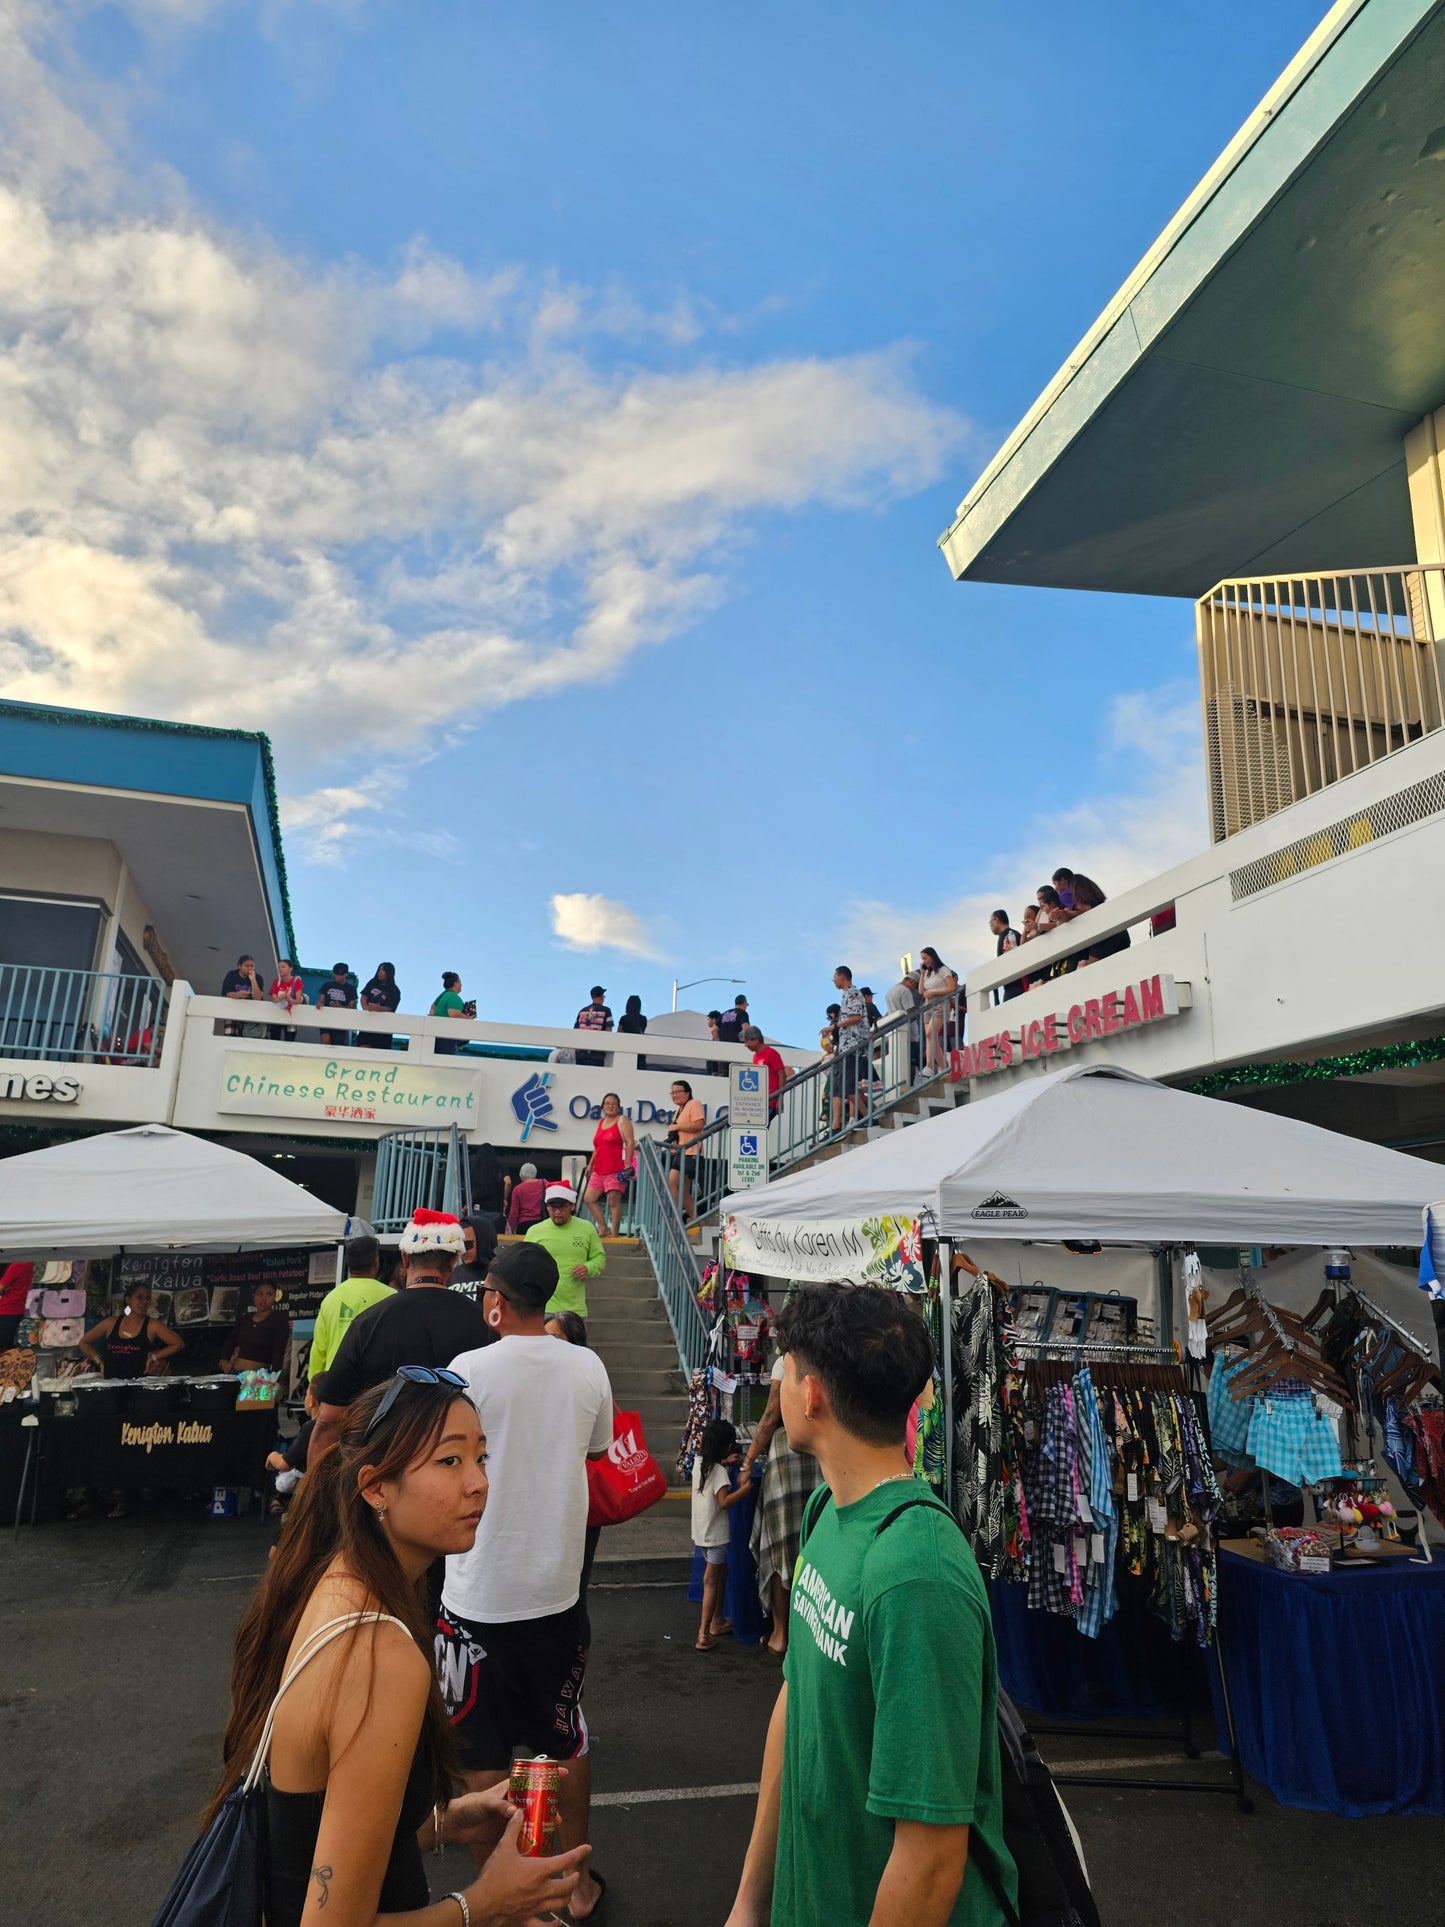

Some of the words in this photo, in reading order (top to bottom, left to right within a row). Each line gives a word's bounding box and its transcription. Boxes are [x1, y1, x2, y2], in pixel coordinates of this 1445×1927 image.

[950, 1030, 1013, 1083] DAVE'S
[1021, 1013, 1059, 1059] ICE
[1067, 974, 1164, 1044] CREAM
[324, 1061, 398, 1084] Grand
[226, 1074, 325, 1099] Chinese
[336, 1082, 475, 1110] Restaurant
[569, 1095, 632, 1121] Oau
[975, 1210, 1000, 1218] EAGLE
[1002, 1210, 1024, 1218] PEAK
[793, 1225, 842, 1257] Karen
[842, 1225, 864, 1257] M
[120, 1255, 203, 1274] Kenigton
[151, 1273, 202, 1289] Kalua
[176, 1420, 213, 1445] Kalua
[213, 1486, 227, 1514] PE
